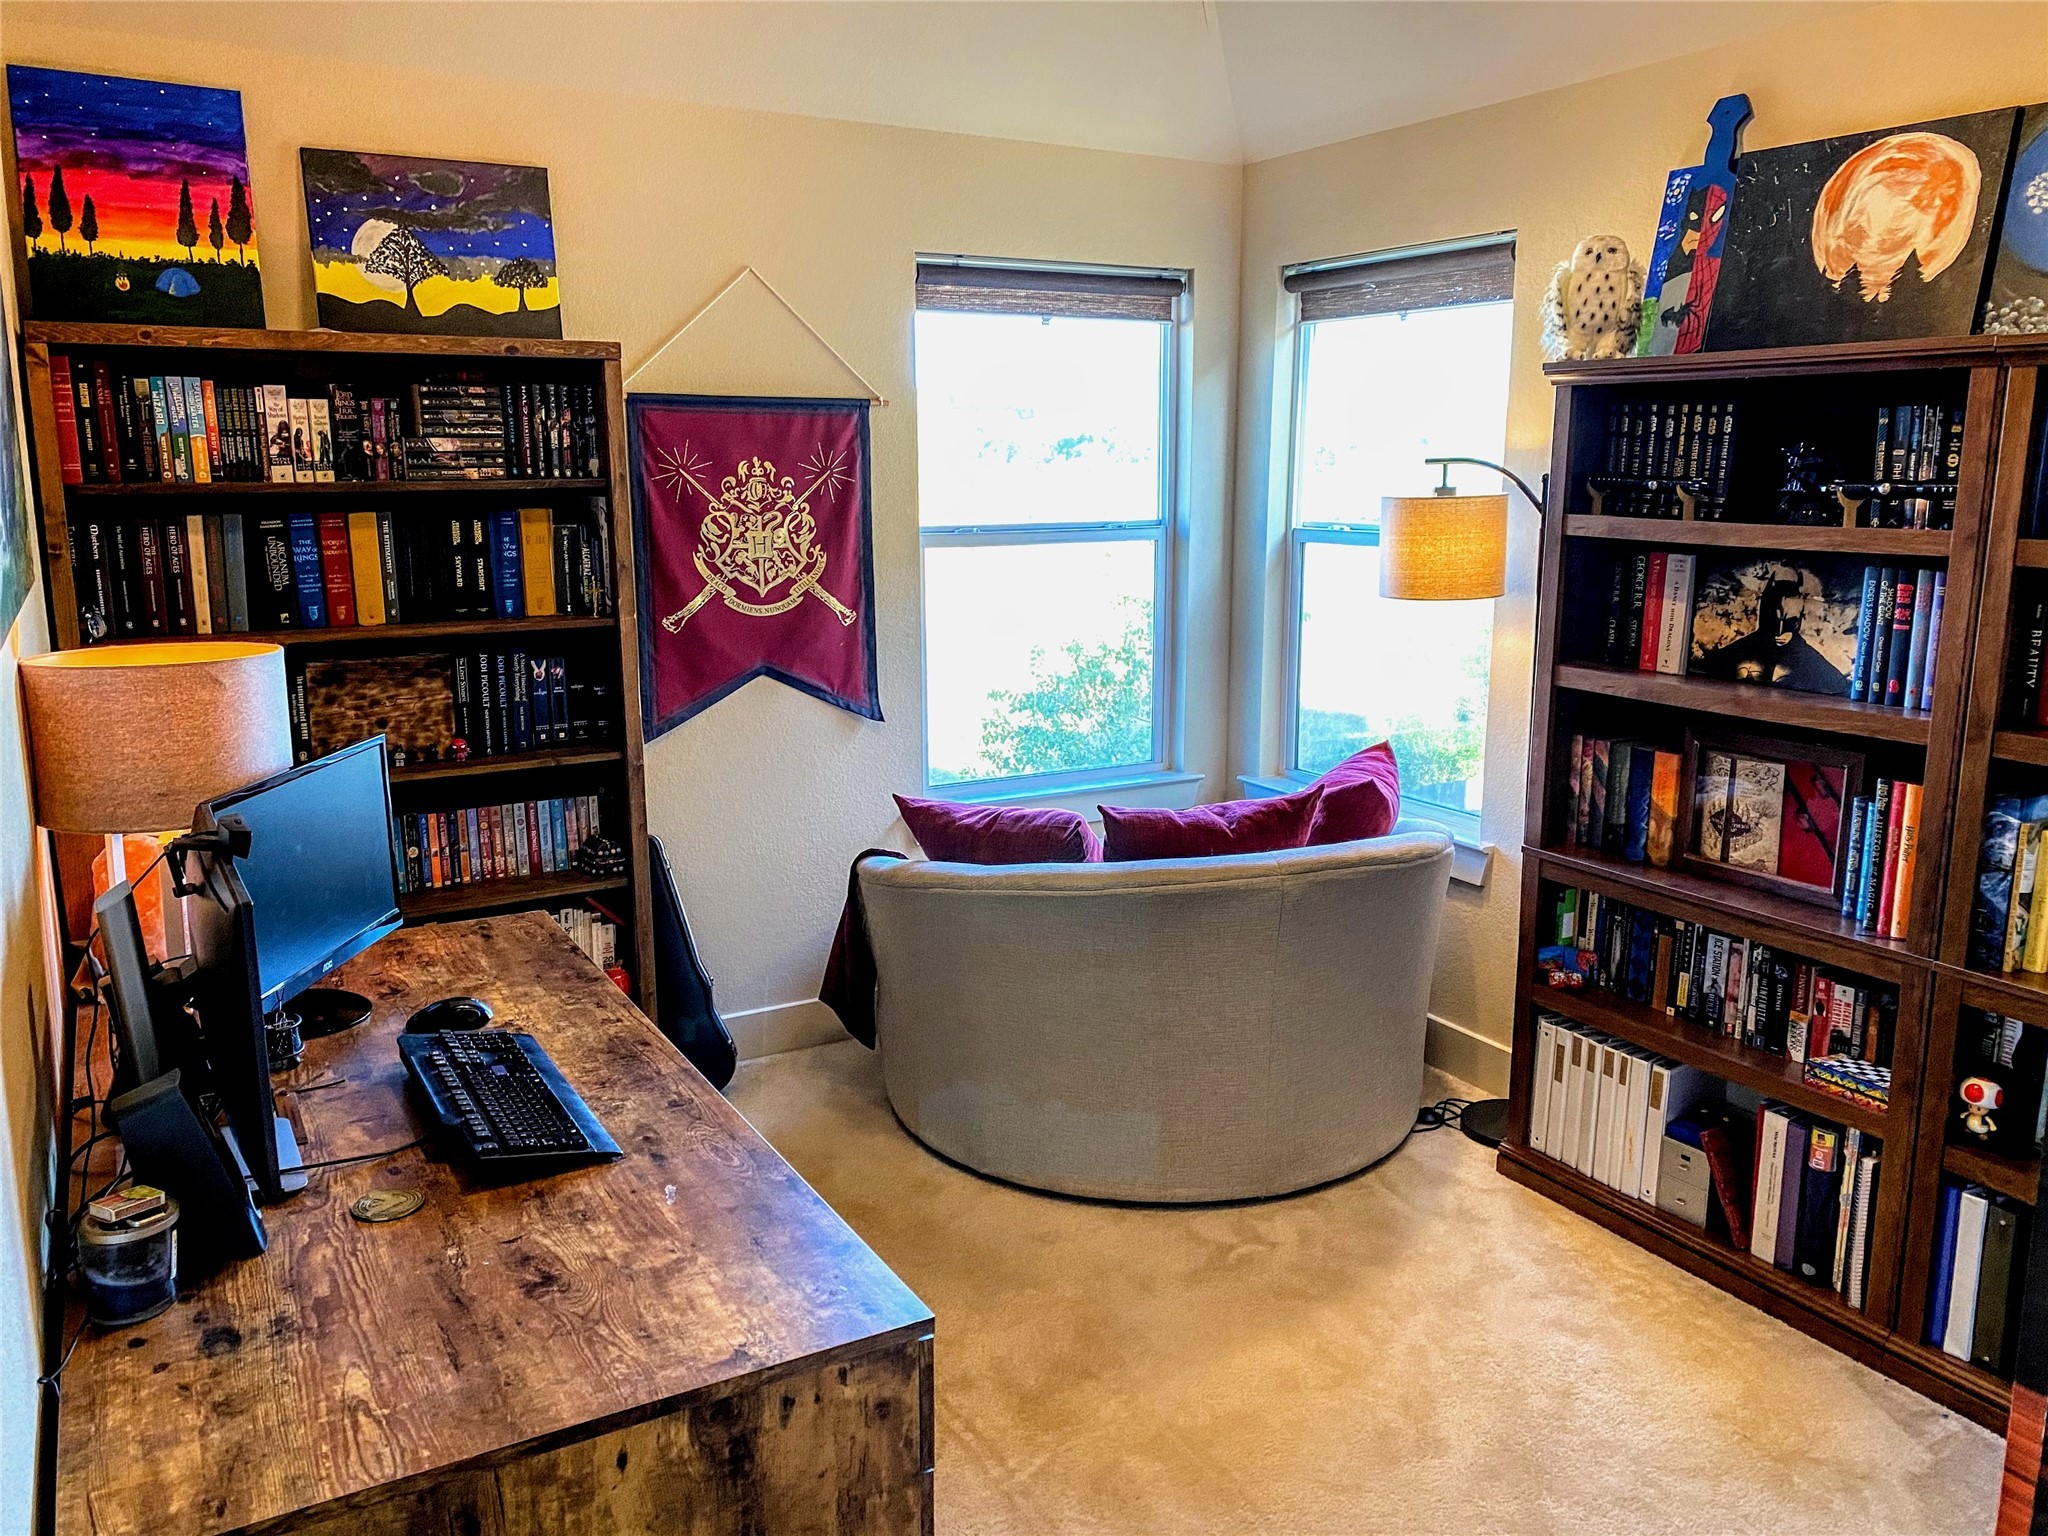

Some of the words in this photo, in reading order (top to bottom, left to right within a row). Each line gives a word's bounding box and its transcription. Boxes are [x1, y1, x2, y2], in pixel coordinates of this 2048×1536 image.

[152, 391, 165, 425] WIZARD
[506, 386, 514, 413] HALO
[1663, 441, 1671, 460] DEATH
[1691, 440, 1699, 459] CESTUS
[1721, 436, 1729, 458] REVENGE
[89, 525, 100, 559] Mistborn
[142, 527, 150, 546] HERO
[168, 526, 176, 545] HERO
[751, 535, 768, 554] H
[144, 548, 151, 556] OF
[171, 546, 178, 555] OF
[267, 536, 283, 592] UNBOUNDED
[276, 541, 290, 586] ARCANUM
[294, 554, 318, 563] KINGS
[383, 534, 393, 573] RITHMATIST
[581, 547, 591, 575] ALCATRAZ
[145, 557, 153, 575] AGES
[172, 556, 180, 574] AGES
[455, 556, 463, 587] SKYWARD
[477, 558, 485, 591] STARSIGHT
[794, 560, 824, 593] TITILLANDUS
[1636, 556, 1646, 591] GEORGE
[706, 574, 727, 592] DRACO
[1672, 587, 1680, 606] DANCE
[1867, 580, 1876, 607] ENDER'S
[729, 598, 762, 614] DORMIENS
[765, 598, 798, 614] NUNQUAM
[1885, 588, 1894, 619] SHADOW
[1629, 620, 1637, 647] STORM
[1666, 623, 1674, 651] DRAGONS
[1863, 609, 1873, 640] SHADOW
[479, 654, 488, 672] JODI
[496, 655, 505, 673] JODI
[481, 675, 490, 708] PICOULT
[498, 676, 507, 708] PICOULT
[1871, 822, 1882, 862] HISTORY
[1905, 826, 1914, 842] Harry
[1903, 844, 1914, 863] Potter
[1868, 877, 1877, 909] MAGIC
[1714, 938, 1723, 949] ICE
[323, 960, 333, 972] AOC
[1711, 950, 1723, 977] STATION
[1705, 994, 1715, 1016] REILLY
[1757, 986, 1768, 1021] INFINITE
[1843, 1002, 1852, 1029] MICHAEL
[1795, 1025, 1805, 1053] ANGELS
